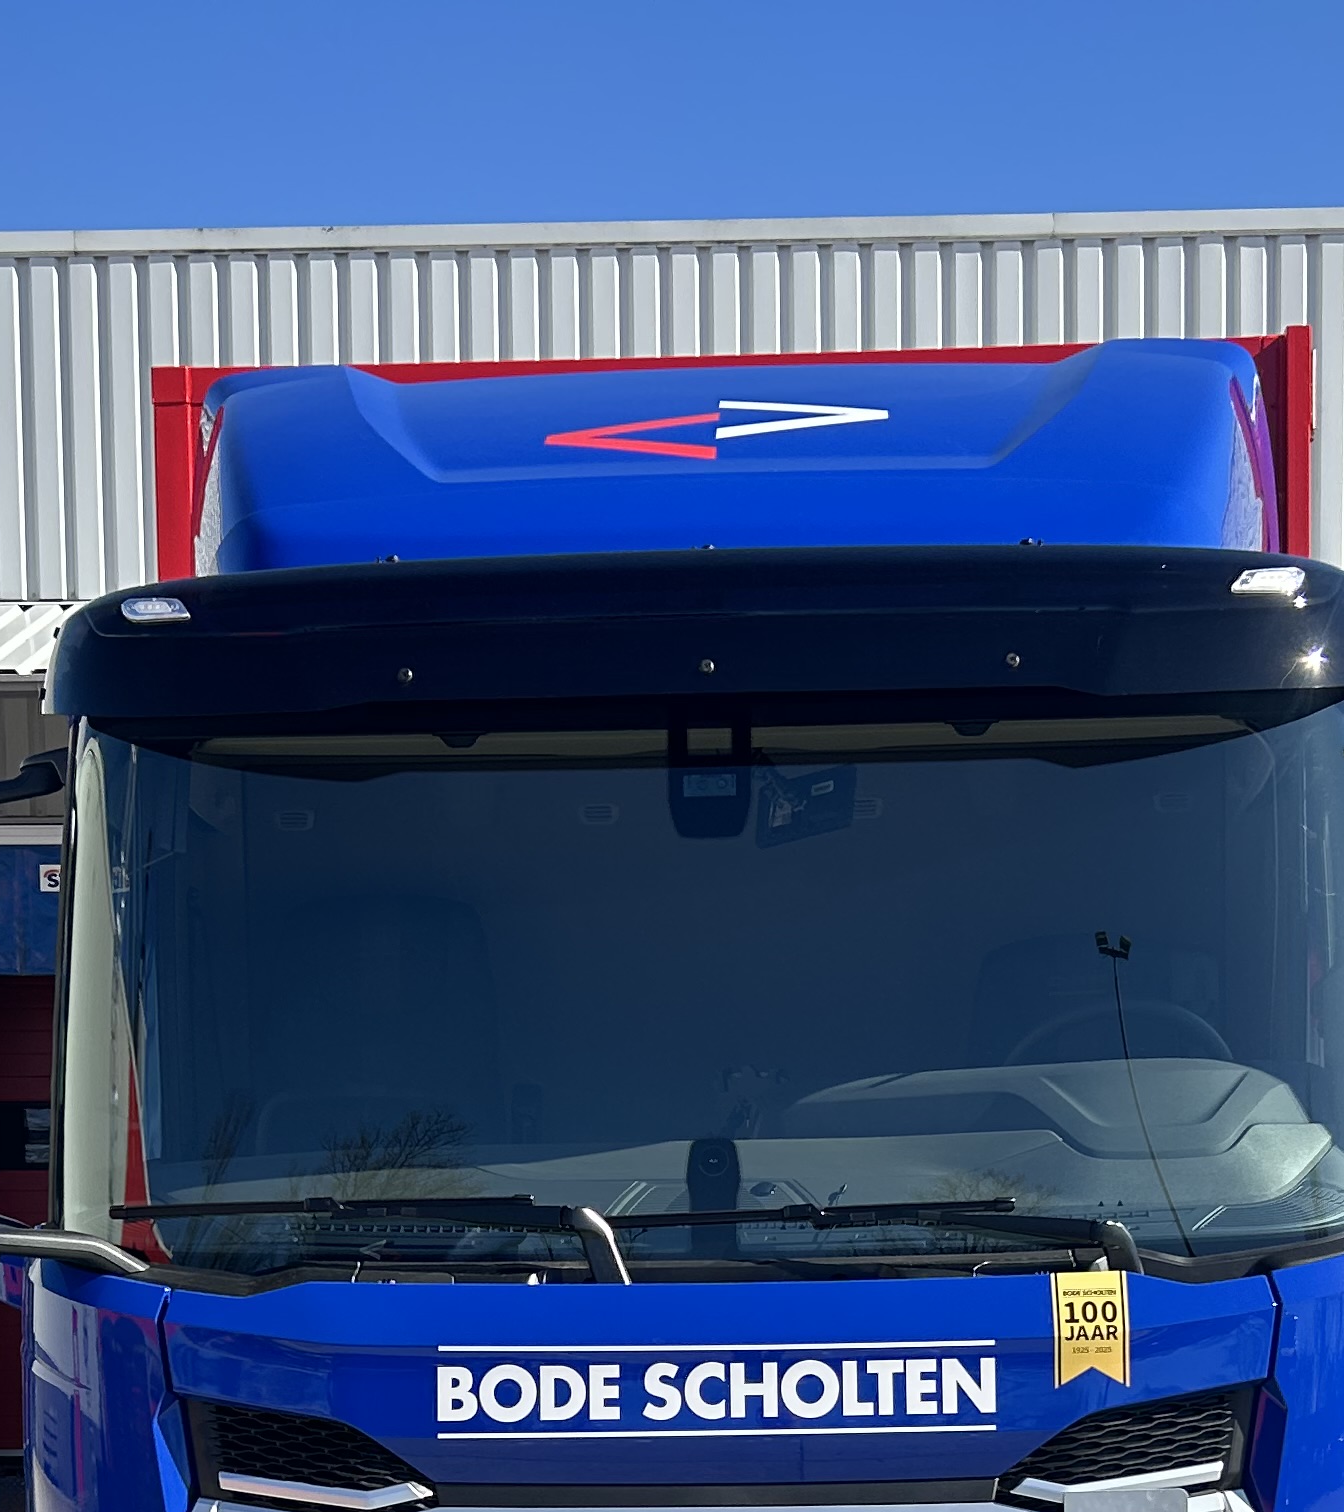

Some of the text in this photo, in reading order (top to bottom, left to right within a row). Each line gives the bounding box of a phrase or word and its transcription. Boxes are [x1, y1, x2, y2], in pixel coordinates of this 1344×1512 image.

[1064, 1300, 1118, 1324] 100
[1064, 1325, 1119, 1342] JAAR
[436, 1356, 997, 1423] BODE SCHOLTEN
